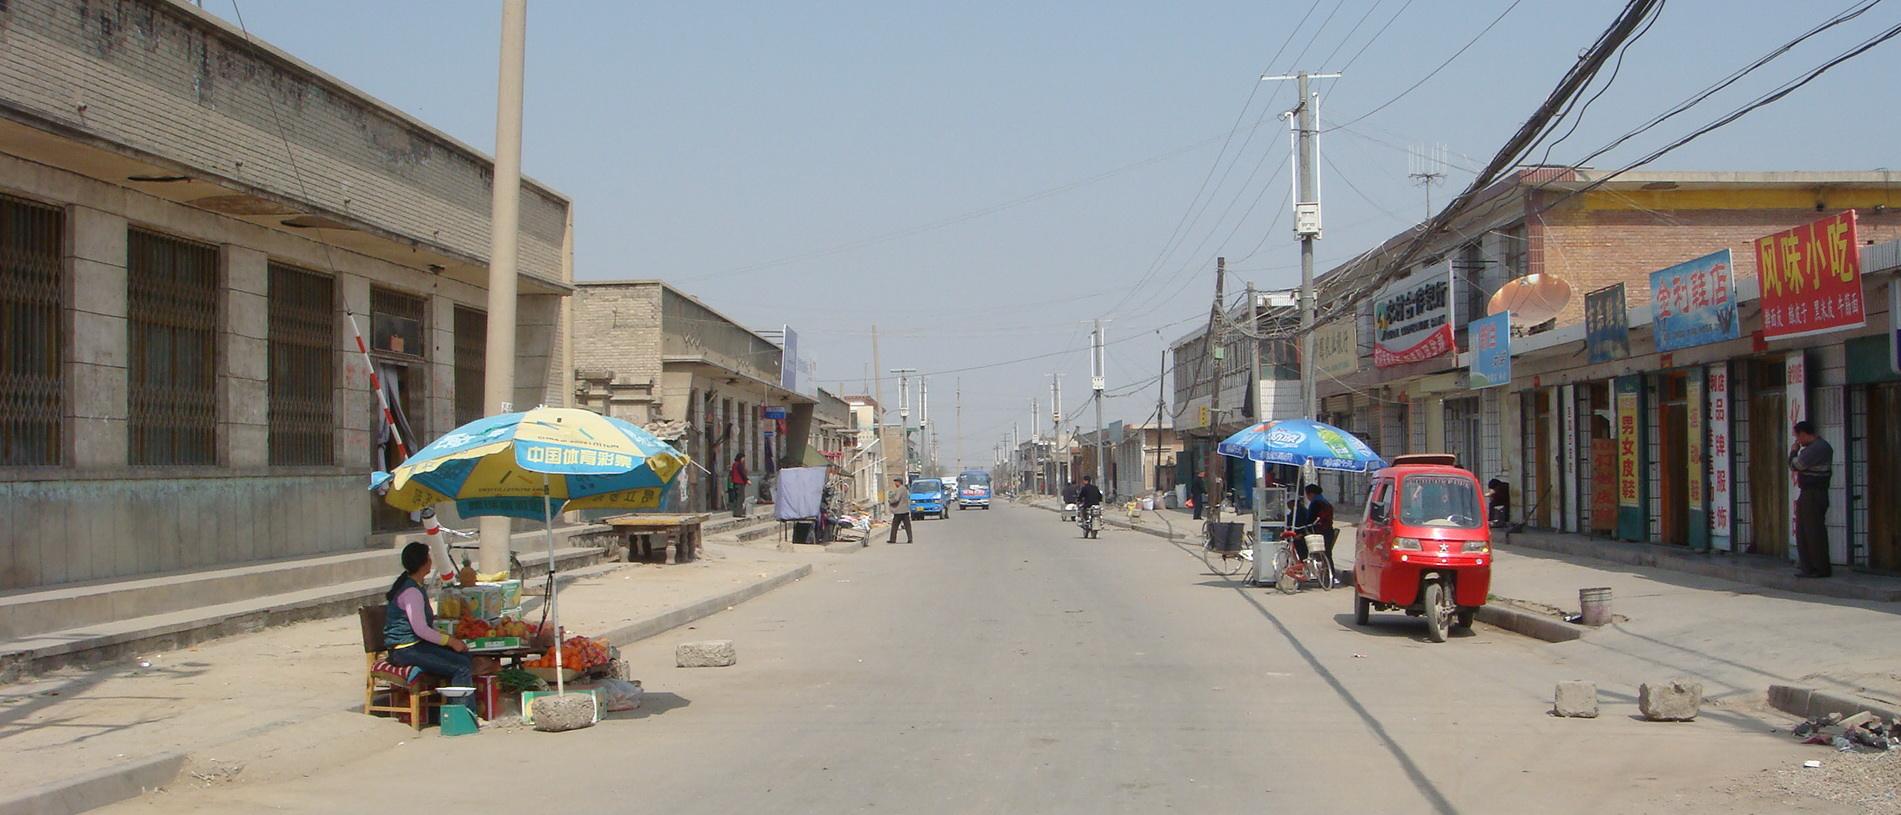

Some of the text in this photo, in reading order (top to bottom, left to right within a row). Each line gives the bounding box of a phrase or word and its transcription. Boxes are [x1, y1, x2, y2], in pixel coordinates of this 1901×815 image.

[1761, 215, 1853, 298] 风味小吃
[527, 446, 632, 468] 中国体育彩票
[1622, 416, 1635, 498] 男女皮鞋
[1715, 399, 1727, 529] 品牌服饰
